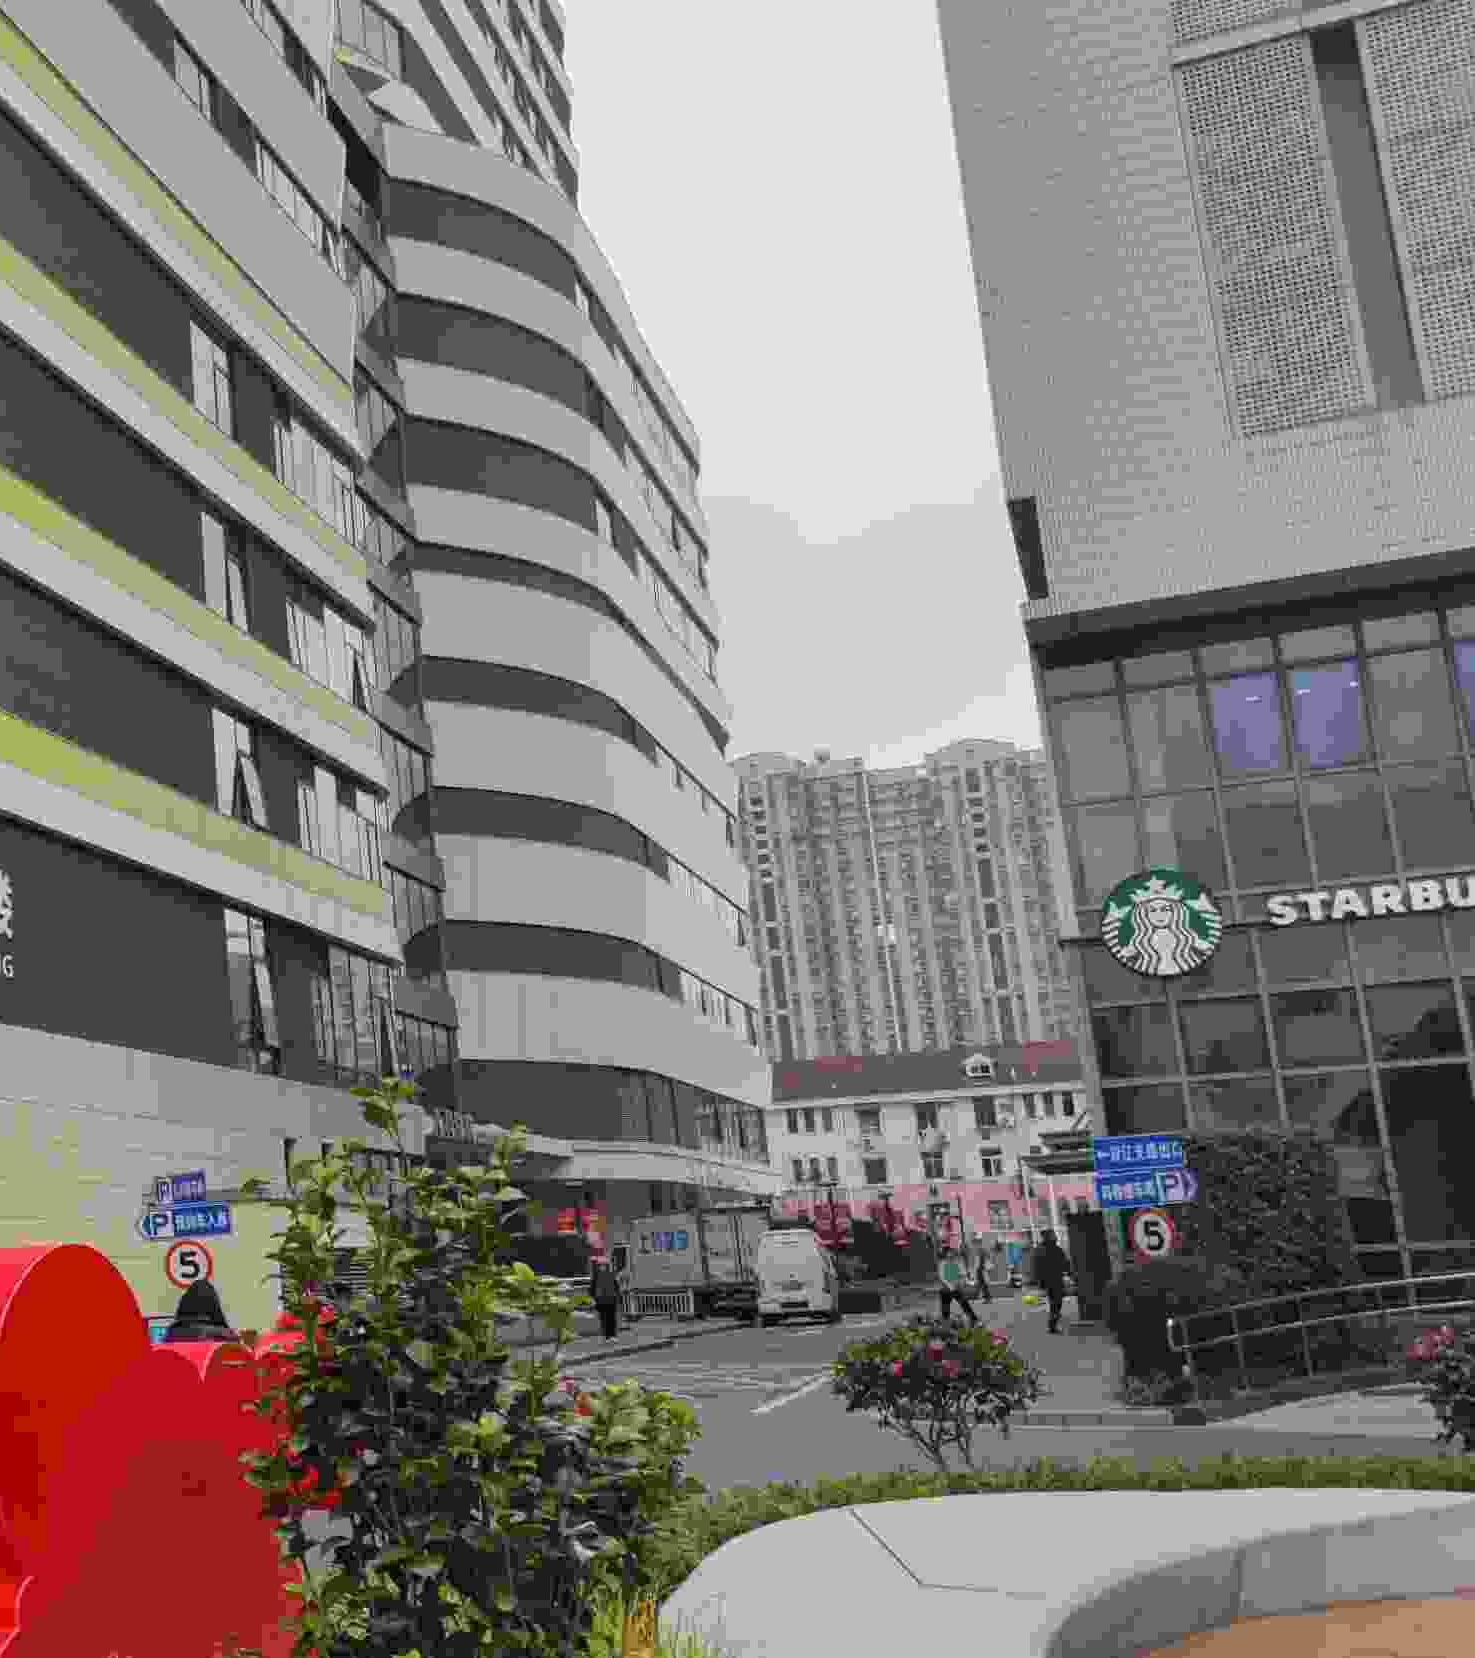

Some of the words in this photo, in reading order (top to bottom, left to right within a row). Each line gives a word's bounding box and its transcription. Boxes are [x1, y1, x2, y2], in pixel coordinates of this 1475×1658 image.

[1267, 875, 1475, 926] STARBU
[1144, 1220, 1164, 1251] 5
[179, 1251, 200, 1279] 5
